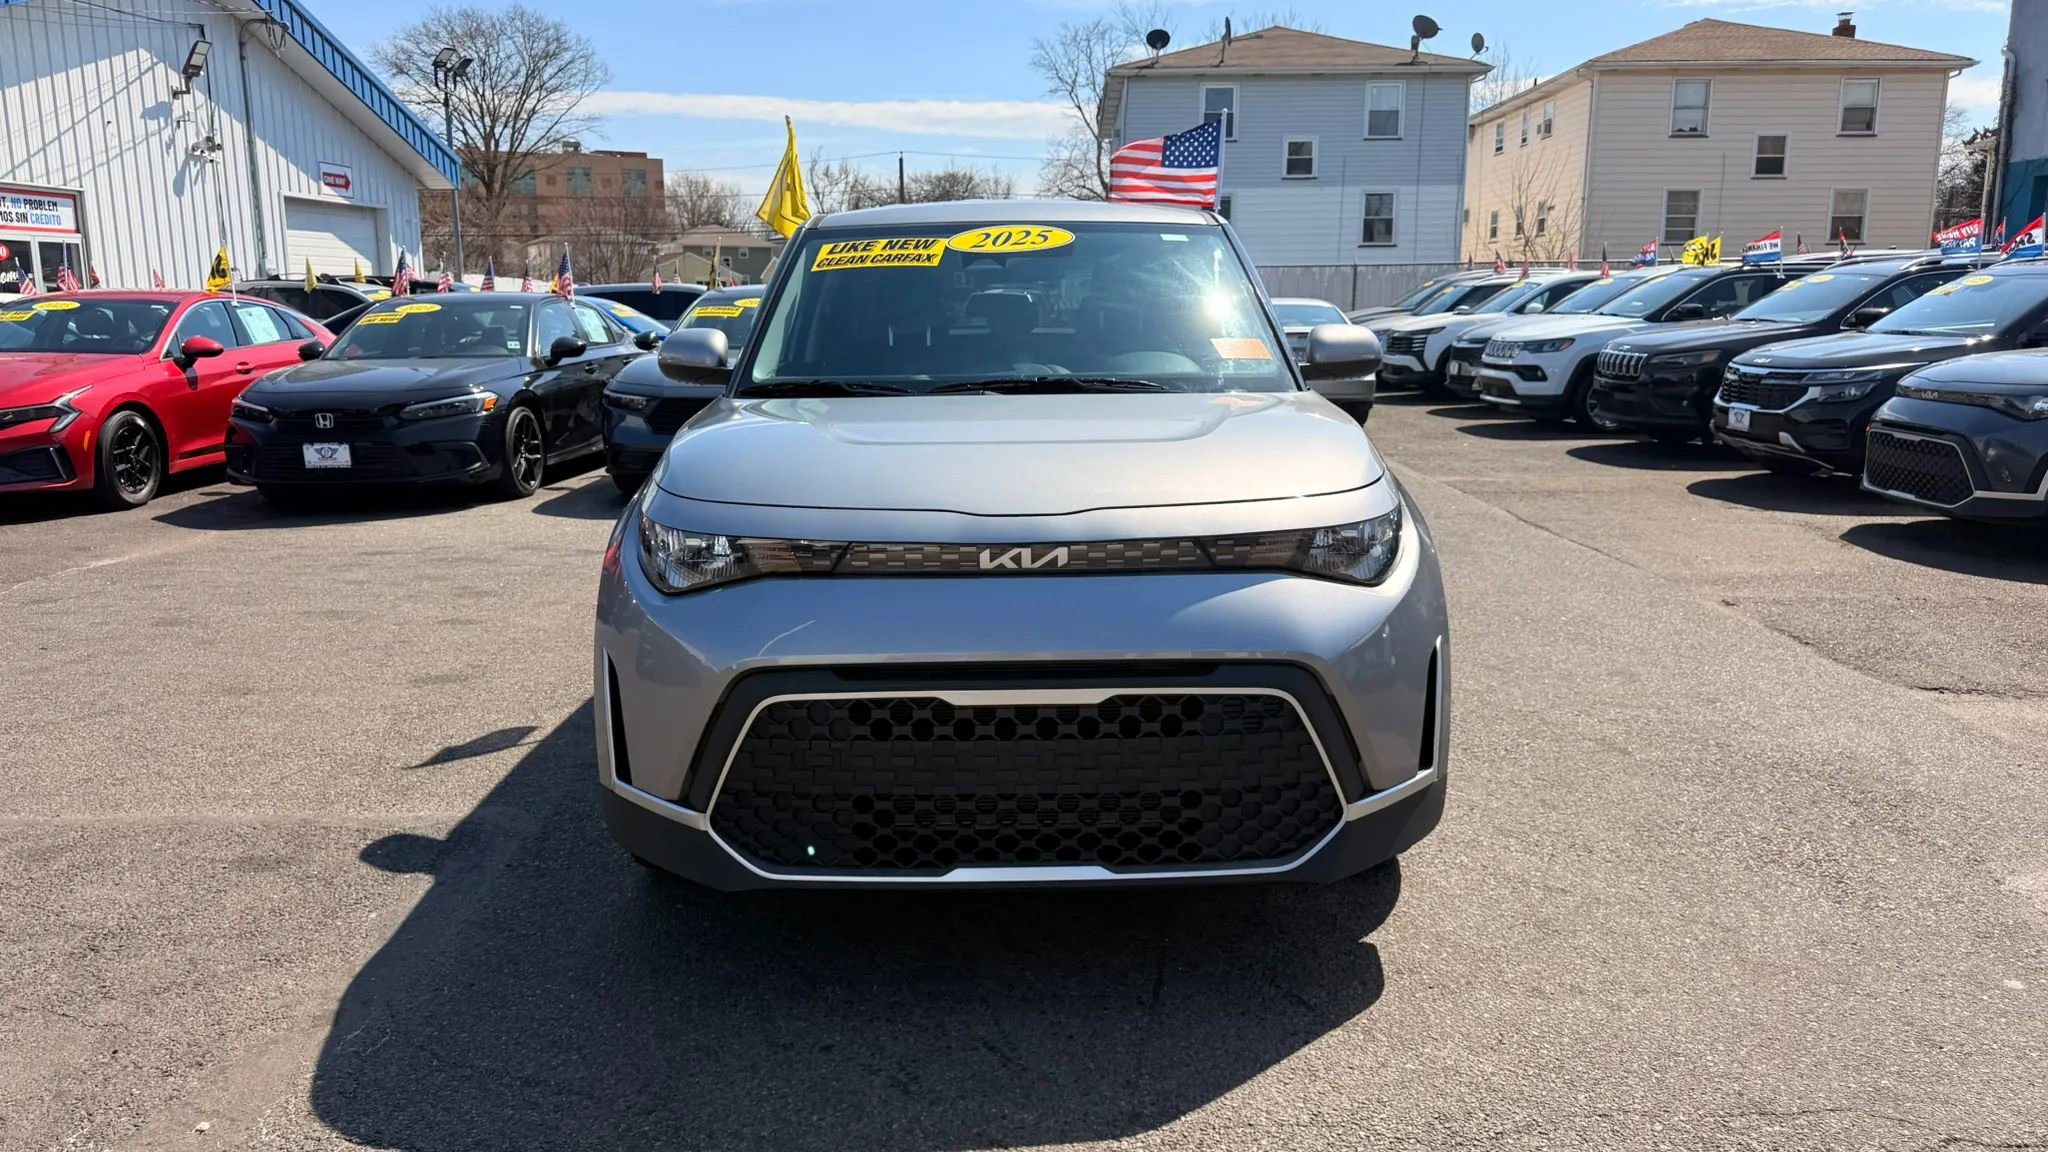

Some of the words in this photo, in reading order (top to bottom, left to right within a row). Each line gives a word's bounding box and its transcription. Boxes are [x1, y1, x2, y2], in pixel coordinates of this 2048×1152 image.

[11, 196, 22, 209] NO
[23, 198, 58, 212] PROBLEM
[15, 212, 28, 224] SIN
[826, 241, 878, 256] LIKE
[881, 239, 938, 251] NEW
[969, 230, 1053, 249] 2025
[816, 254, 869, 268] CLEAN
[870, 253, 938, 265] CARFAX
[979, 546, 1069, 569] KIA
